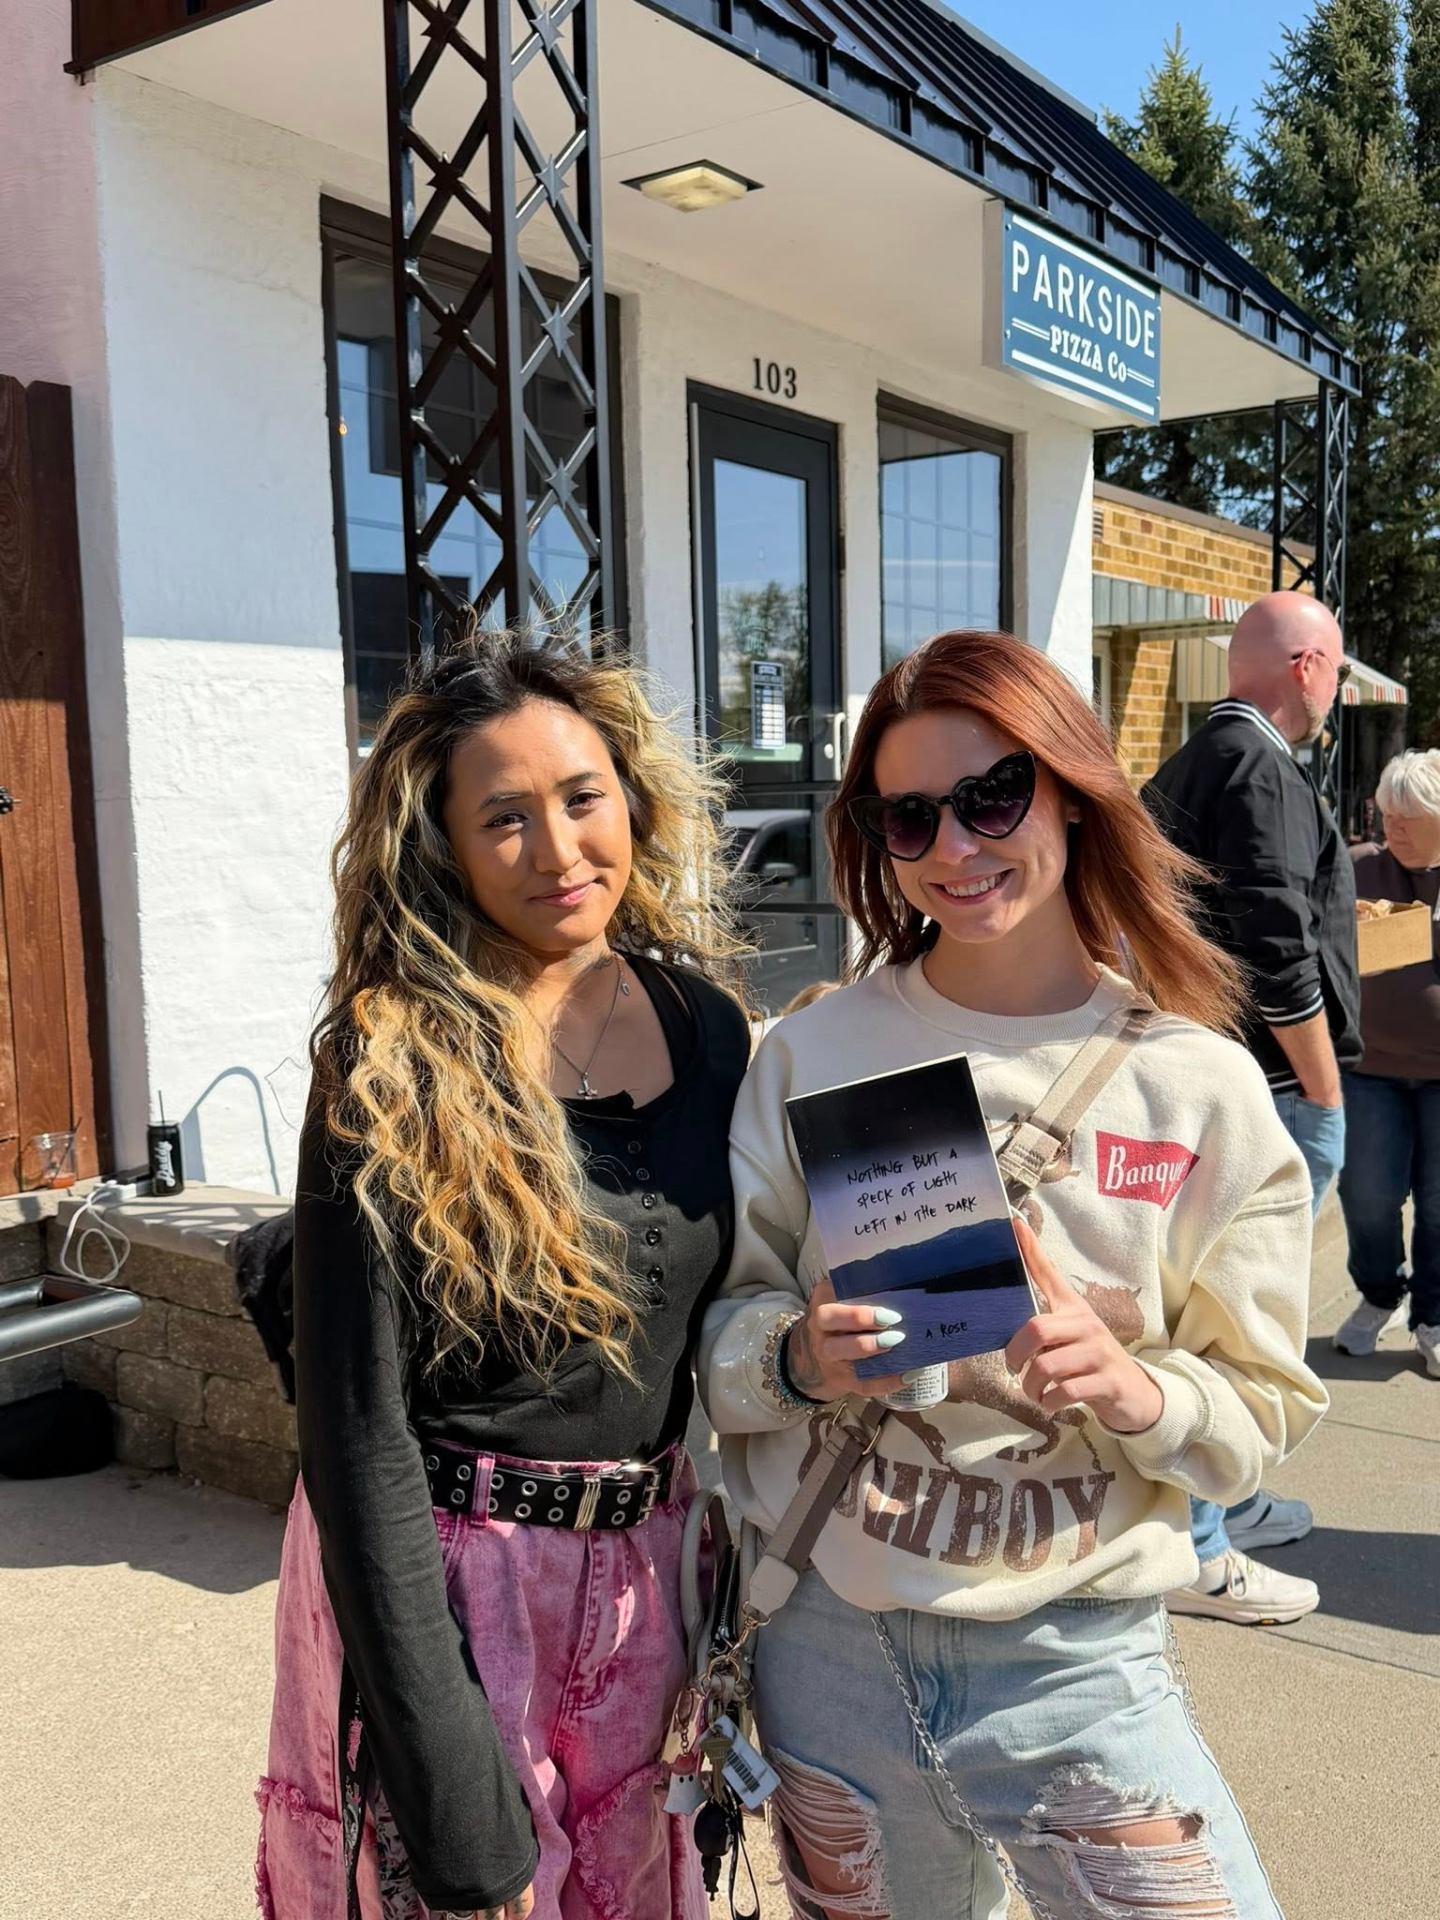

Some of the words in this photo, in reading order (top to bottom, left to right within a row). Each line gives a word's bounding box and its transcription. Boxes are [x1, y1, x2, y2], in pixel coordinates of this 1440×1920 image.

[1012, 240, 1156, 358] PARKSIDE
[1050, 324, 1104, 373] PIZZA
[1107, 351, 1127, 383] Co
[752, 357, 797, 399] 103
[154, 1141, 176, 1187] Daddy
[847, 1160, 903, 1185] NOTHING
[912, 1151, 939, 1171] BUT
[949, 1147, 958, 1160] A
[857, 1188, 894, 1210] SPECK
[901, 1181, 916, 1198] OF
[924, 1170, 958, 1191] LIGHT
[854, 1217, 888, 1236] LEFT
[895, 1210, 907, 1226] IN
[914, 1204, 937, 1223] THE
[944, 1196, 977, 1213] DARK
[925, 1327, 933, 1339] A
[940, 1321, 968, 1339] ROSE
